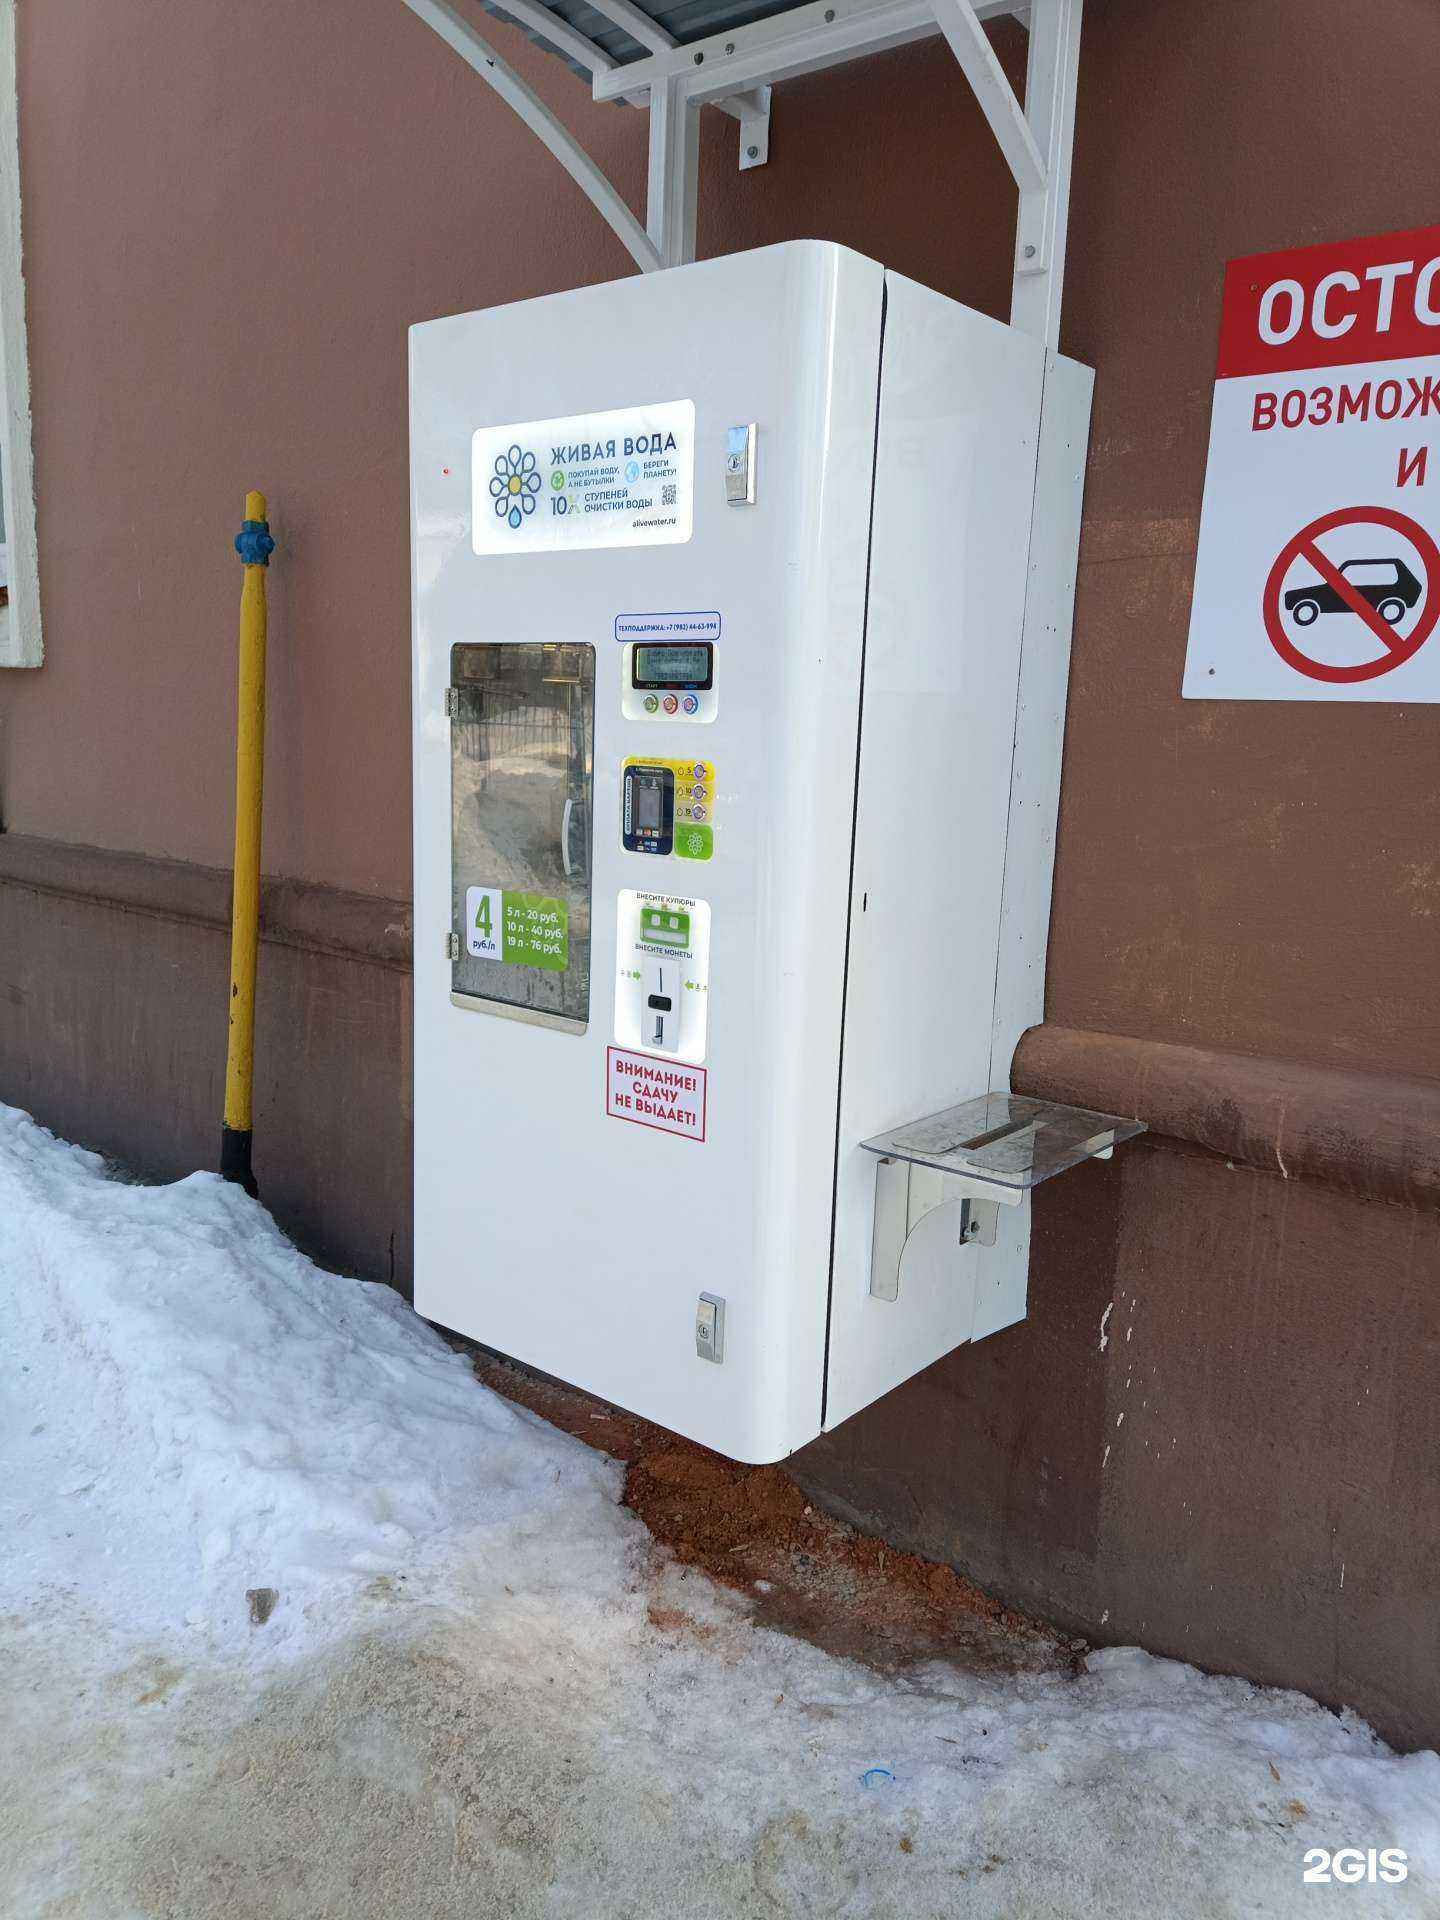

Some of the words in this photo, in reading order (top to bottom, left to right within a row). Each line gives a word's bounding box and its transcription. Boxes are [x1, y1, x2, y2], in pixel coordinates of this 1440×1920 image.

[1252, 376, 1440, 432] ВОЗМОЖ
[551, 440, 616, 466] ЖИВАЯ
[624, 432, 677, 456] ВОДА
[643, 460, 669, 470] БЕРЕГИ
[1396, 446, 1428, 487] И
[568, 468, 599, 479] ПОКУПАЙ
[643, 469, 677, 479] ПЛАНЕТУ!
[574, 479, 584, 488] НЕ
[584, 477, 615, 487] БУТЫЛКИ
[584, 489, 628, 503] СТУПЕНЕЙ
[551, 496, 568, 516] 10
[584, 500, 624, 513] ОЧИСТКИ
[626, 498, 653, 510] ВОДЫ
[632, 517, 676, 528] alivewater.ru
[636, 892, 665, 903] ВНЕСИТЕ
[666, 896, 696, 906] КУПЮРЫ
[475, 895, 492, 938] 4
[507, 907, 512, 916] 5
[514, 910, 520, 918] л
[527, 910, 538, 920] 20
[507, 922, 516, 931] 10
[531, 926, 542, 936] 40
[508, 936, 516, 946] 19
[531, 940, 542, 950] 76
[635, 944, 662, 954] ВНЕСИТЕ
[664, 948, 693, 959] МОНЕТЫ
[616, 1060, 697, 1092] ВНИМАНИЕ!
[632, 1081, 678, 1104] СДАЧУ
[615, 1093, 632, 1109] НЕ
[635, 1098, 696, 1126] ВЫДАЕТ!
